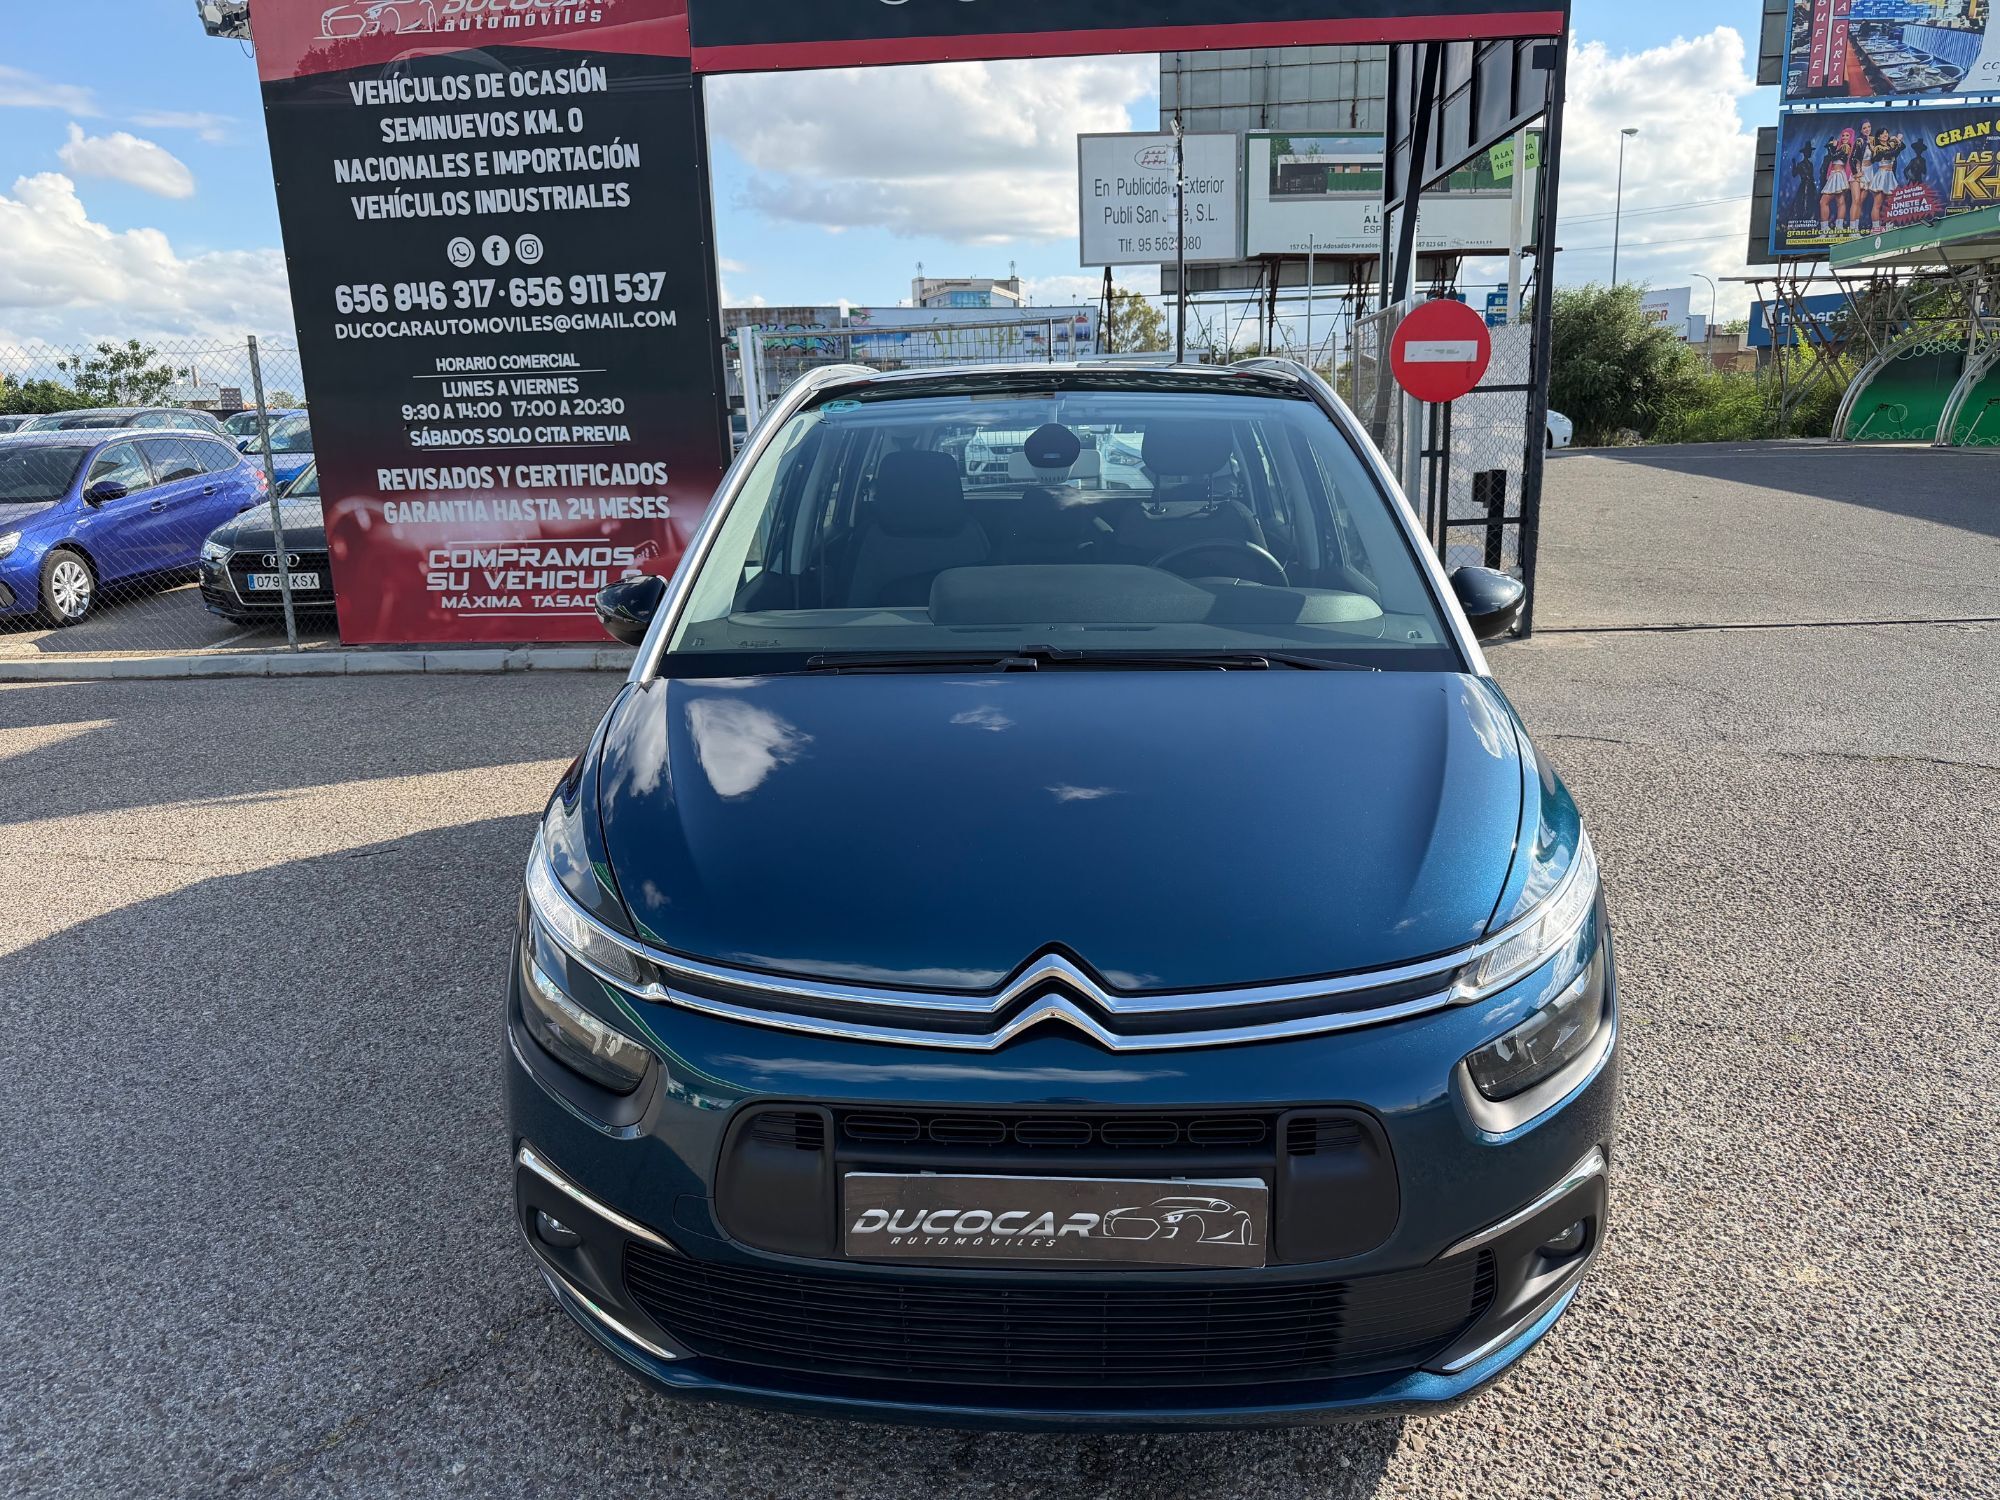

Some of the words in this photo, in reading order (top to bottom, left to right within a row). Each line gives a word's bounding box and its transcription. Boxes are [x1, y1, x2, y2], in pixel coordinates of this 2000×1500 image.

[443, 8, 602, 32] automóviles
[1830, 24, 1844, 84] CARTA
[349, 71, 470, 105] VEHÍCULOS
[475, 72, 506, 98] DE
[510, 60, 607, 97] OCASIÓN
[380, 111, 519, 143] SEMINUEVOS
[524, 109, 563, 134] KM.
[1936, 121, 1991, 147] GRAN
[334, 153, 470, 183] NACIONALES
[475, 152, 489, 175] E
[493, 137, 640, 174] IMPORTACIÓN
[1496, 162, 1504, 170] 16
[1955, 151, 1993, 163] LAS
[1095, 179, 1109, 197] En
[1117, 178, 1174, 196] Publicida
[351, 187, 470, 220] VEHÍCULOS
[475, 182, 631, 214] INDUSTRIALES
[1887, 205, 1932, 217] NOSOTRAS!
[1104, 206, 1133, 224] Publi
[1136, 205, 1158, 223] San
[1196, 204, 1218, 221] S.L.
[1138, 238, 1151, 252] 95
[336, 284, 388, 313] 656
[394, 281, 447, 311] 846
[453, 279, 495, 308] 317
[509, 277, 563, 307] 656
[570, 275, 609, 304] 911
[615, 272, 666, 302] 537
[335, 311, 676, 339] DUCOCARAUTOMOVILES@GMAIL.COM
[436, 356, 496, 371] HORARIO
[500, 354, 580, 369] COMERCIAL
[443, 380, 494, 397] LUNES
[498, 379, 508, 395] A
[511, 378, 579, 395] VIERNES
[402, 404, 439, 420] 9:30
[444, 403, 454, 419] A
[456, 402, 501, 418] 14:00
[511, 400, 556, 416] 17:00
[560, 400, 571, 415] A
[574, 398, 624, 414] 20:30
[410, 426, 484, 446] SÁBADOS
[487, 427, 531, 444] SOLO
[535, 426, 569, 443] CITA
[572, 425, 630, 442] PREVIA
[378, 466, 494, 490] REVISADOS
[497, 466, 511, 488] Y
[515, 462, 668, 487] CERTIFICADOS
[493, 499, 562, 521] HASTA
[567, 498, 595, 519] 24
[599, 497, 670, 519] MESES
[428, 547, 635, 569] COMPRAMOS
[257, 575, 280, 588] 079
[291, 574, 318, 588] KSX
[427, 572, 470, 590] SU
[441, 593, 522, 608] MÁXIMA
[532, 594, 597, 608] TASAC
[850, 1208, 1100, 1237] DUCOCAR
[890, 1236, 1056, 1248] AUTOMÓVILES
